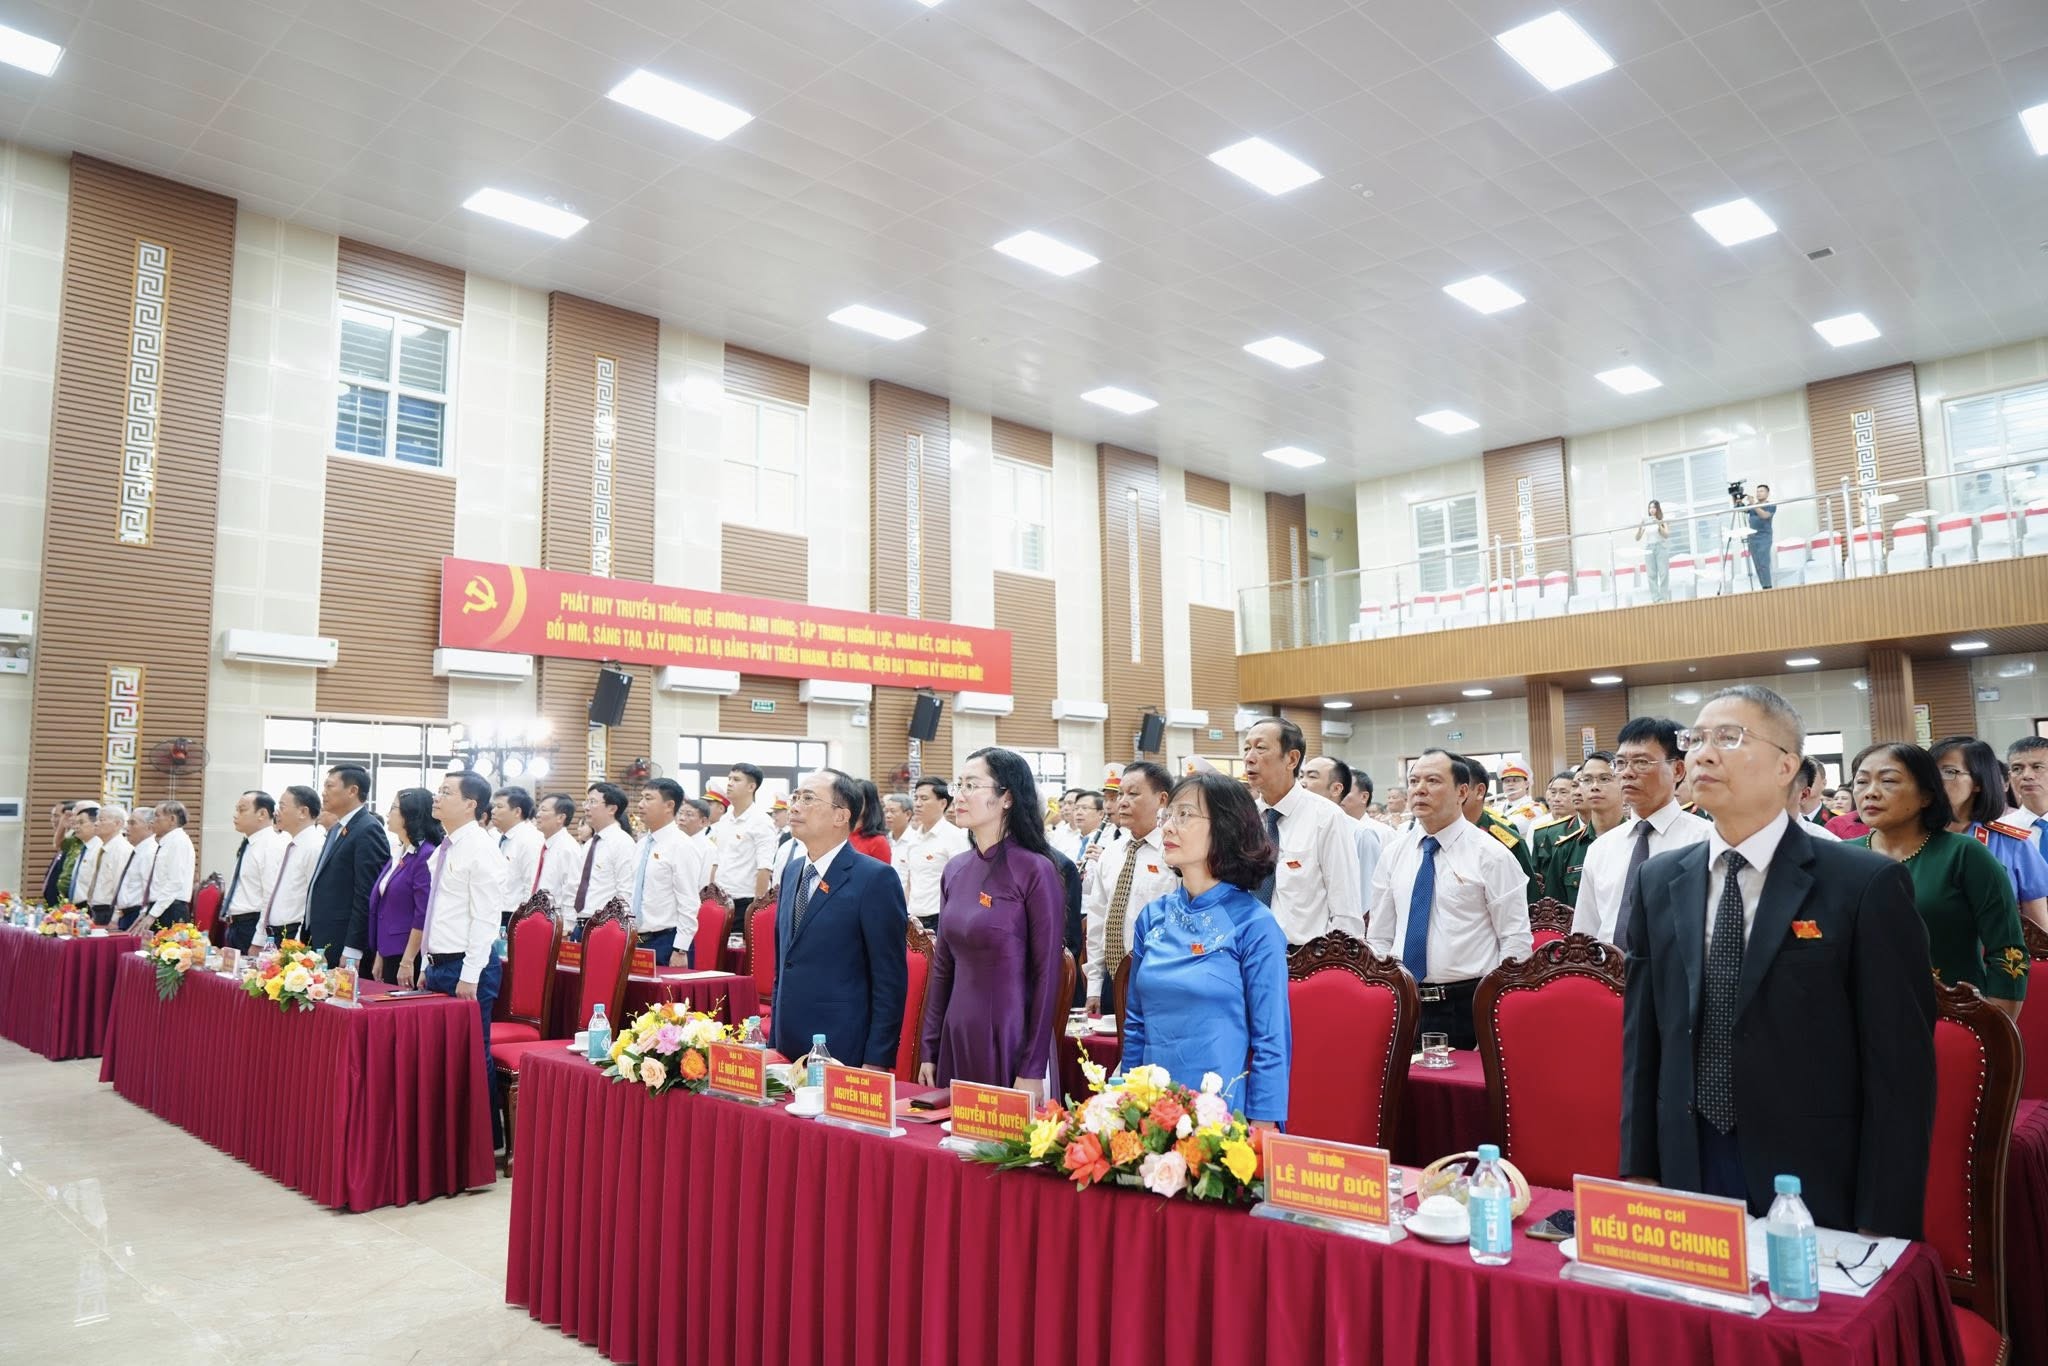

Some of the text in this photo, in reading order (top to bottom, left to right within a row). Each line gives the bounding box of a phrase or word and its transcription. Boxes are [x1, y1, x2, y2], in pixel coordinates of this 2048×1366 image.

[560, 590, 589, 613] PHÁT
[591, 596, 613, 616] HUY
[658, 600, 691, 625] THỐNG
[693, 607, 713, 628] QUÊ
[715, 611, 748, 631] HƯƠNG
[749, 615, 769, 634] ANH
[799, 619, 816, 642] TẬP
[818, 623, 846, 643] TRUNG
[546, 615, 565, 640] ĐỔI
[567, 620, 591, 645] MỚI,
[593, 623, 621, 647] SÁNG
[623, 628, 645, 651] TẠO,
[646, 629, 666, 651] XÂY
[667, 633, 694, 656] DỰNG
[695, 634, 709, 655] XÃ
[710, 638, 723, 660] HẠ
[750, 641, 773, 662] PHÁT
[834, 1085, 883, 1110] NGUYỄN THỊ HUỆ
[953, 1104, 986, 1123] NGUYỄN
[999, 1113, 1026, 1130] QUYÊN
[1275, 1163, 1382, 1199] LÊ NHƯ ĐỨC
[1627, 1202, 1687, 1224] ĐỒNG CHÍ
[1632, 1223, 1665, 1248] CAO
[1670, 1230, 1730, 1260] CHUNG
